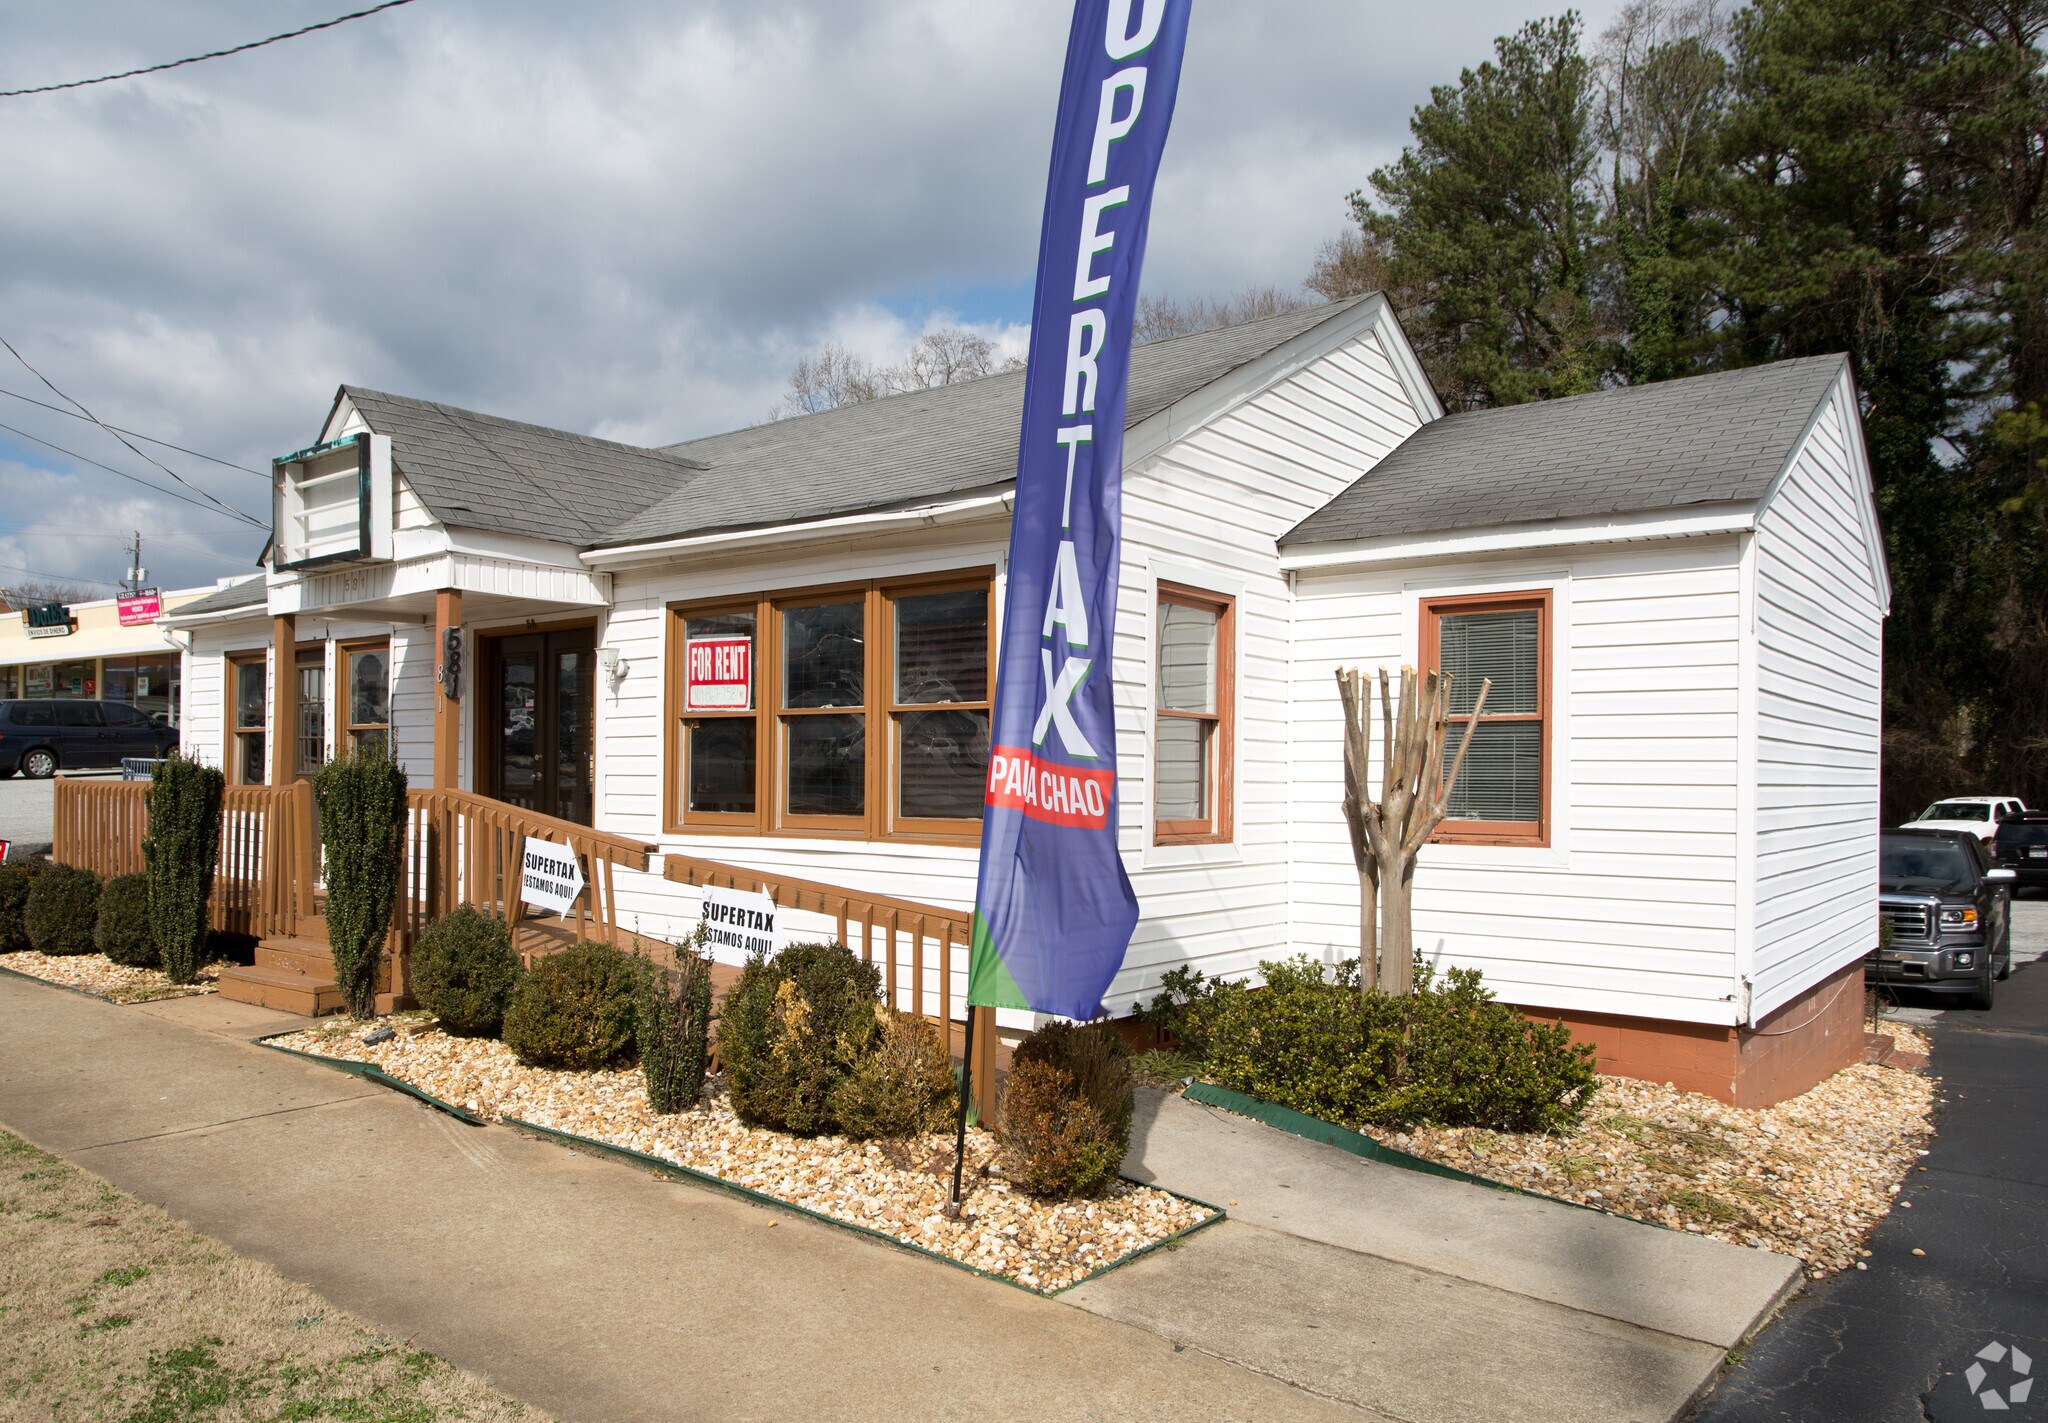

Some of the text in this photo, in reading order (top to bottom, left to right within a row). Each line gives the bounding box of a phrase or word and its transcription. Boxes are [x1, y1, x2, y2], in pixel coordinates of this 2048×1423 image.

[344, 577, 365, 591] 581
[28, 628, 43, 636] ENVIOS
[50, 626, 66, 635] DINERO
[691, 645, 746, 681] FOR RENT
[1040, 771, 1105, 817] CHAO
[525, 852, 575, 880] SUPERTAX
[554, 882, 574, 900] AQUI!
[702, 901, 774, 933] SUPERTAX
[744, 936, 772, 955] AQUI!
